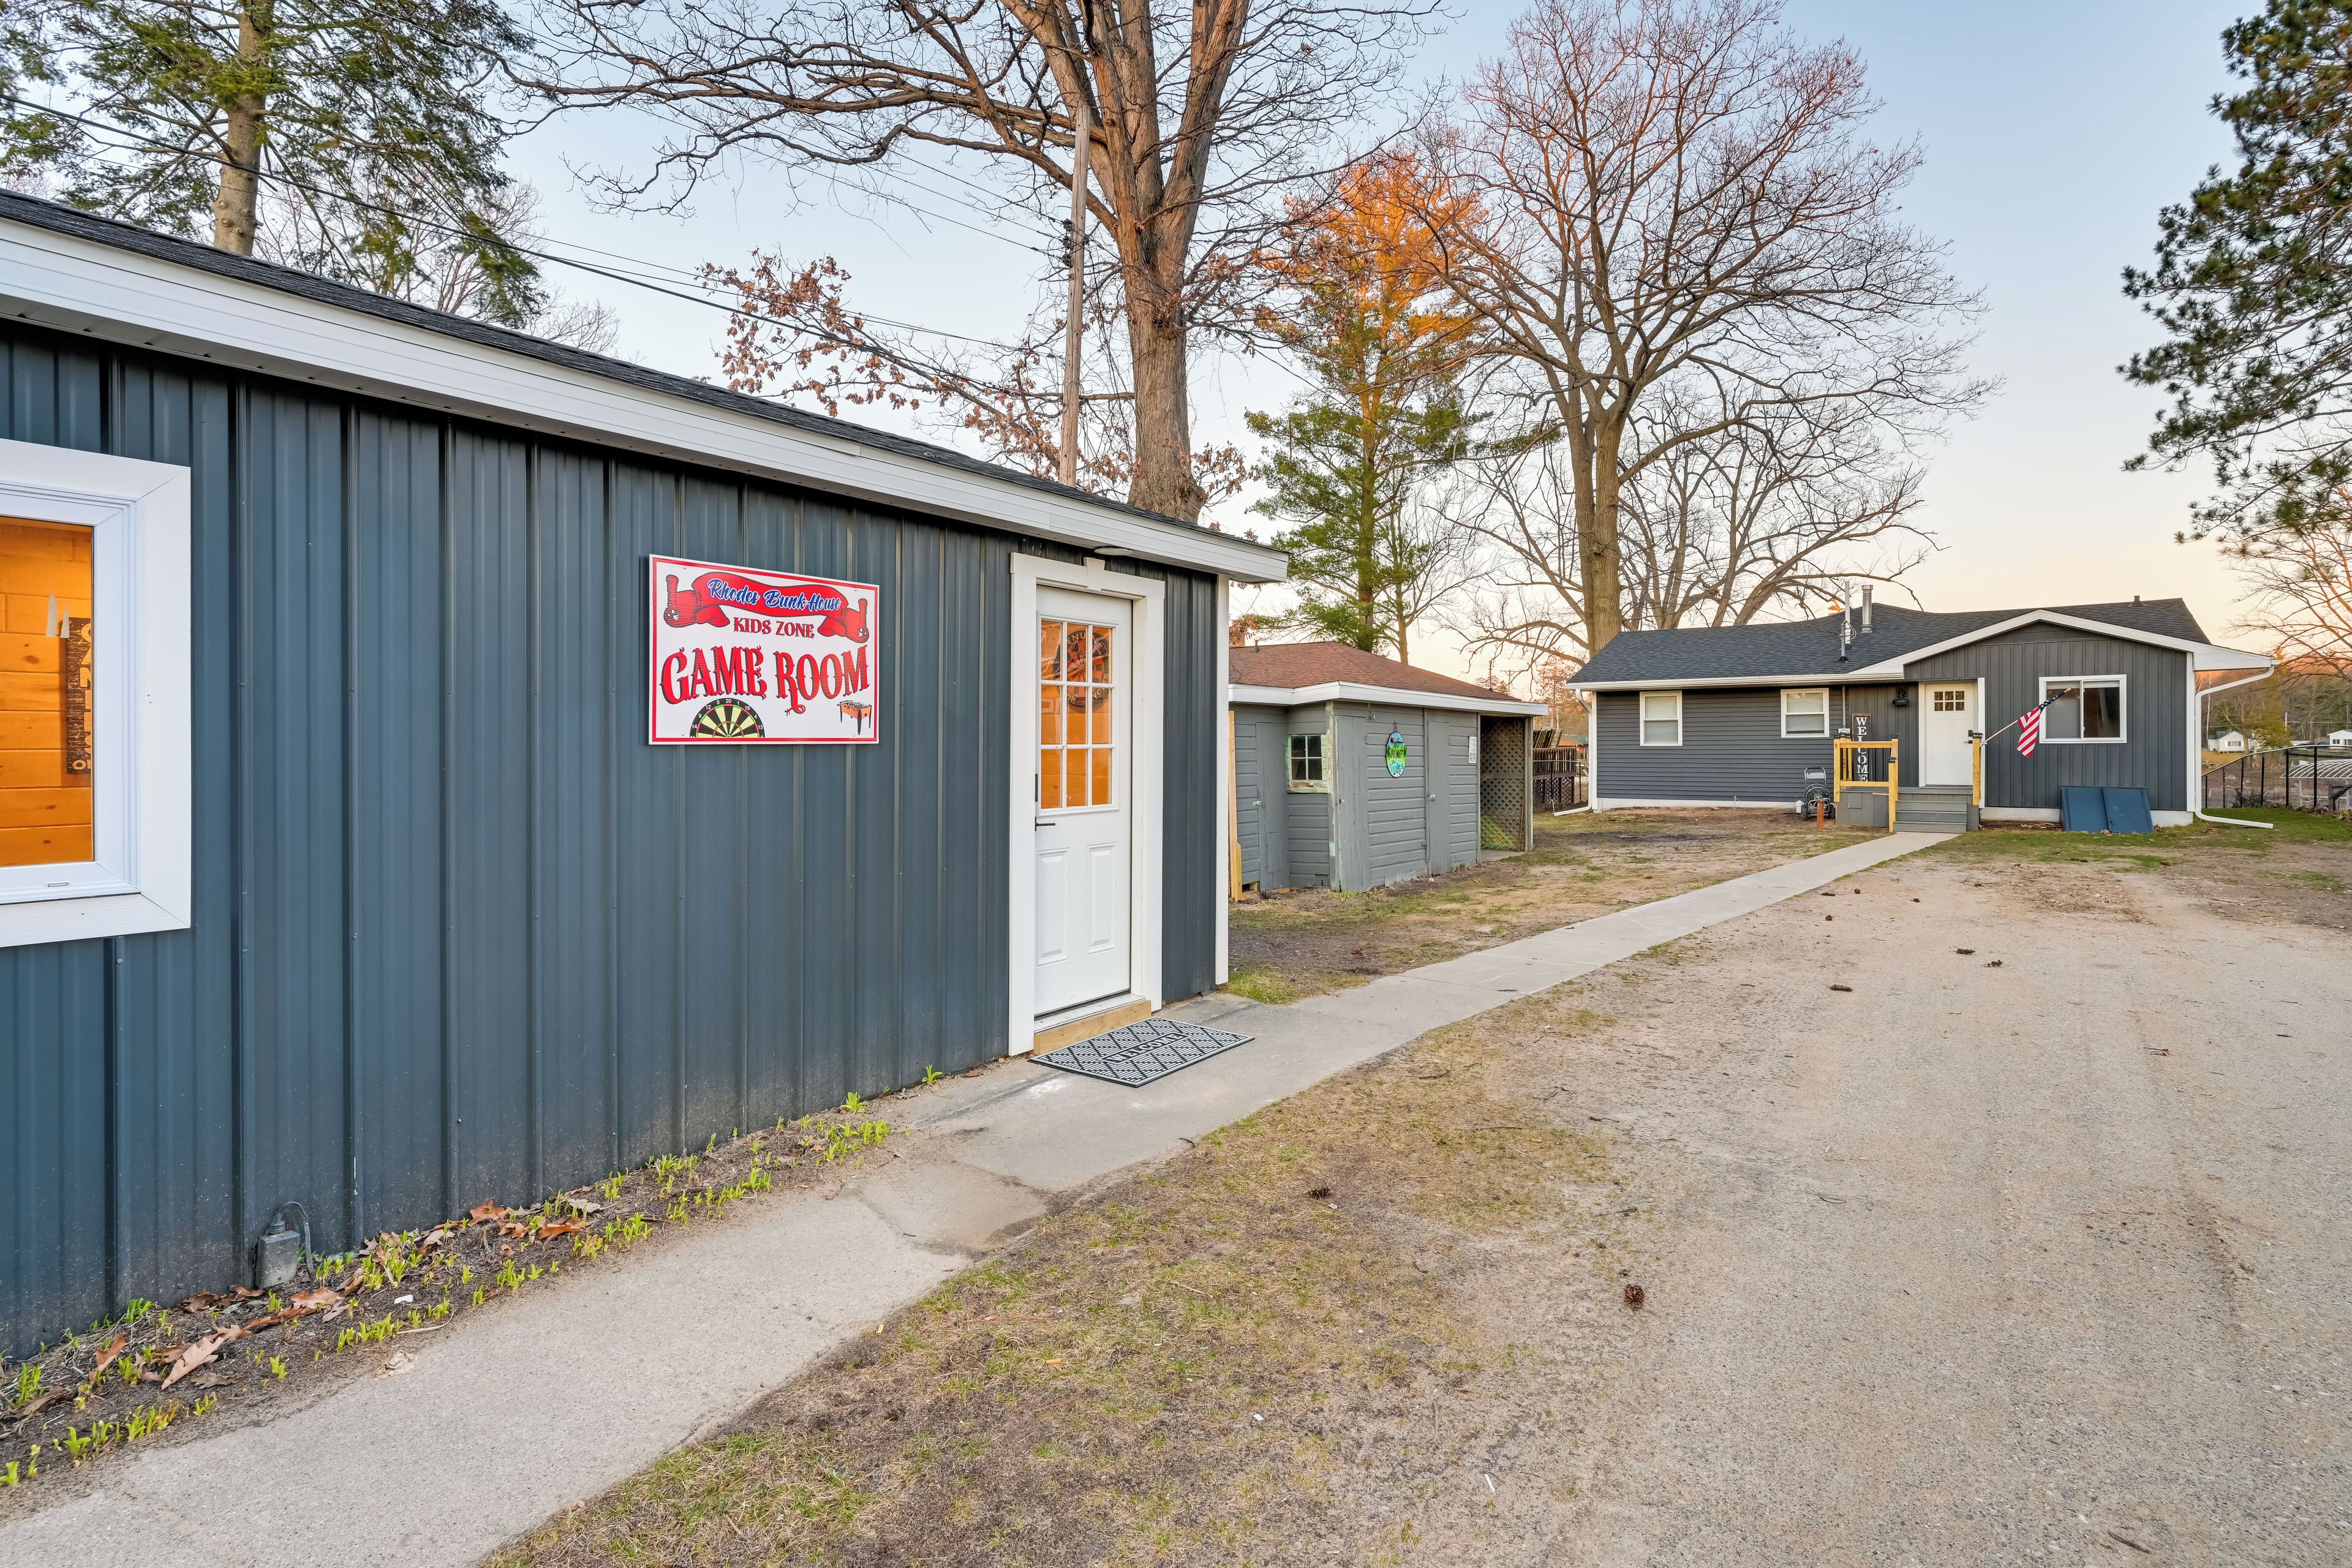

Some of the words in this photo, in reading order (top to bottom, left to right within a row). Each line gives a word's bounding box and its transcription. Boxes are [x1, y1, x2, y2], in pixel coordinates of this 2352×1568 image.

[707, 578, 760, 605] Rhodes
[763, 589, 807, 609] Bunk
[806, 592, 842, 612] House
[733, 616, 772, 635] KIDS
[775, 620, 815, 639] ZONE
[660, 645, 768, 704] GAME
[773, 644, 870, 716] ROOM
[1390, 748, 1403, 760] JUMP
[1106, 1033, 1184, 1061] WELCOME
